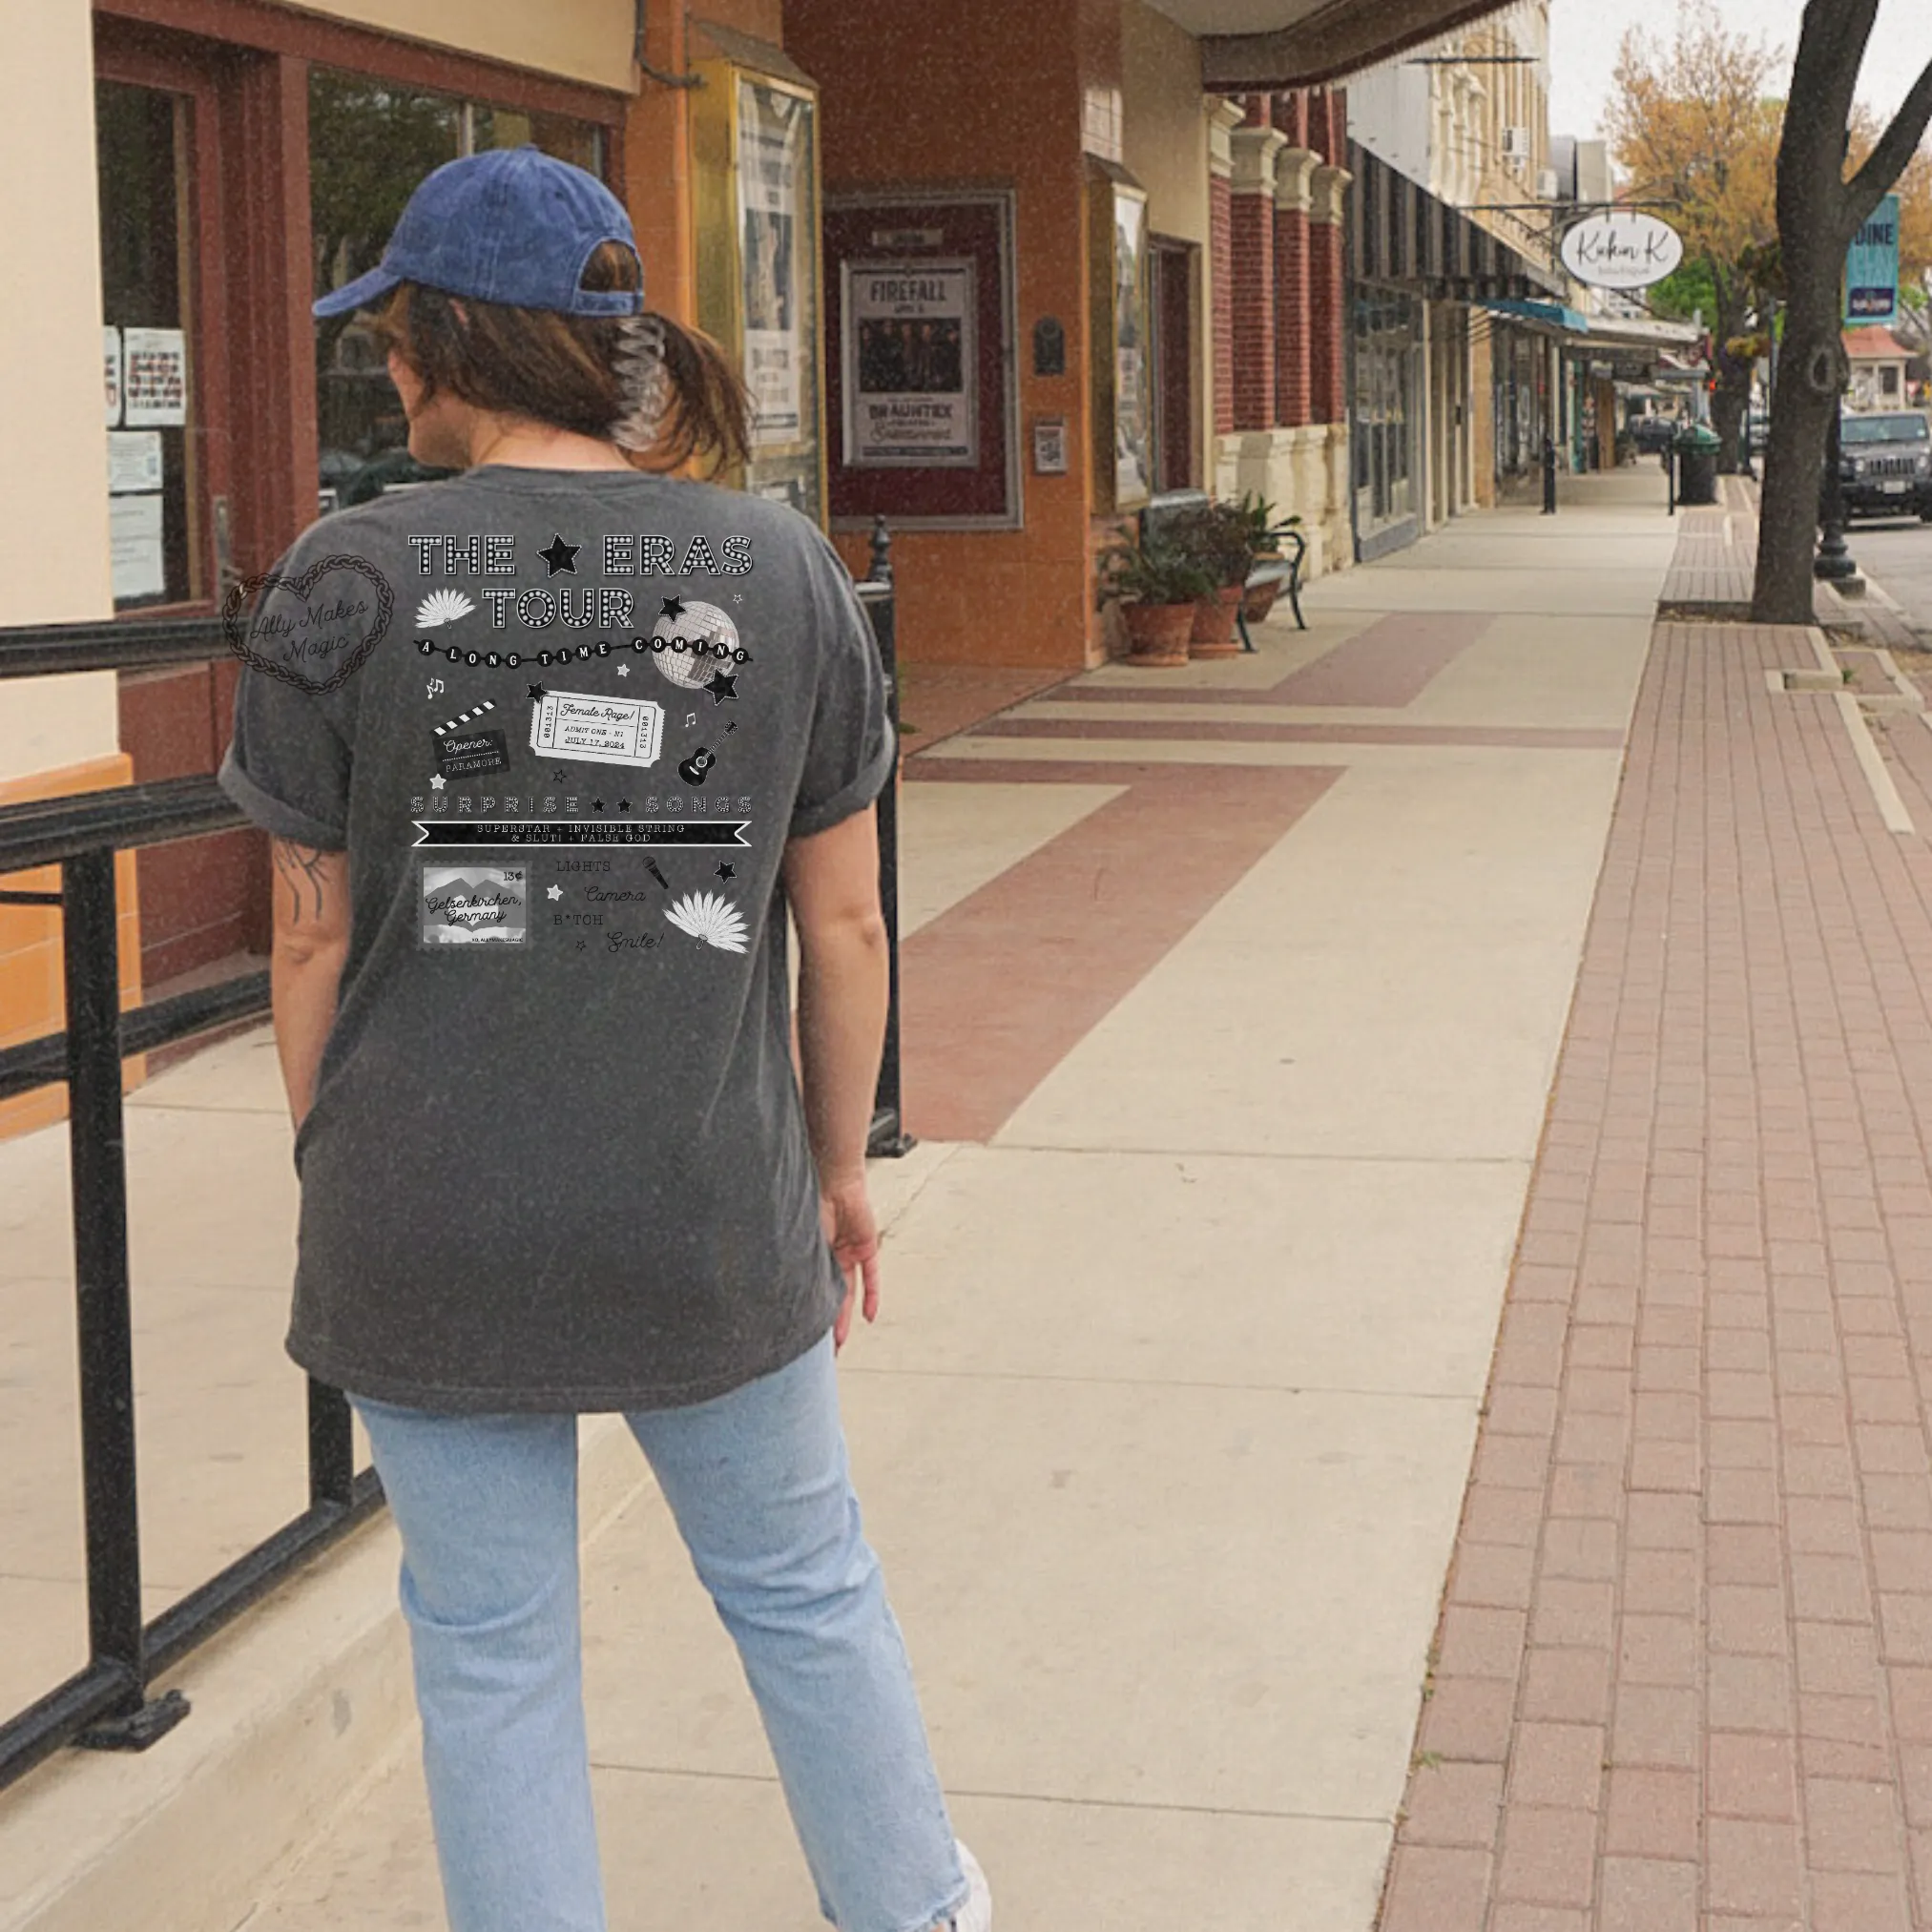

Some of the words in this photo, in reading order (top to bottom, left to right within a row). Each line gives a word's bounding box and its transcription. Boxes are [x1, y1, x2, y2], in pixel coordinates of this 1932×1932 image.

[1644, 230, 1670, 264] K
[870, 280, 947, 301] FIREFALL
[408, 535, 515, 575] THE
[603, 535, 753, 575] ERAS
[482, 589, 634, 628] TOUR
[449, 646, 518, 666] LONG
[541, 642, 607, 664] TIME
[635, 637, 745, 661] COMING
[560, 703, 600, 717] Female
[601, 708, 635, 721] Rage!
[444, 739, 493, 755] Opener:
[565, 737, 587, 745] JULY
[604, 740, 625, 749] 2024
[446, 758, 502, 772] PARAMORE
[410, 796, 579, 813] SURPRISE
[645, 796, 753, 813] SONGS
[477, 824, 551, 833] SUPERSTAR
[569, 824, 633, 833] INVISIBLE
[637, 824, 685, 833] STRING
[511, 834, 520, 842] &
[580, 834, 619, 842] FALSE
[625, 834, 651, 842] GOD
[556, 861, 611, 872] LIGHTS
[584, 885, 646, 902] Camera
[426, 893, 522, 914] Gelsenkirchen,
[445, 909, 507, 926] Germany
[607, 931, 665, 953] Smile!
